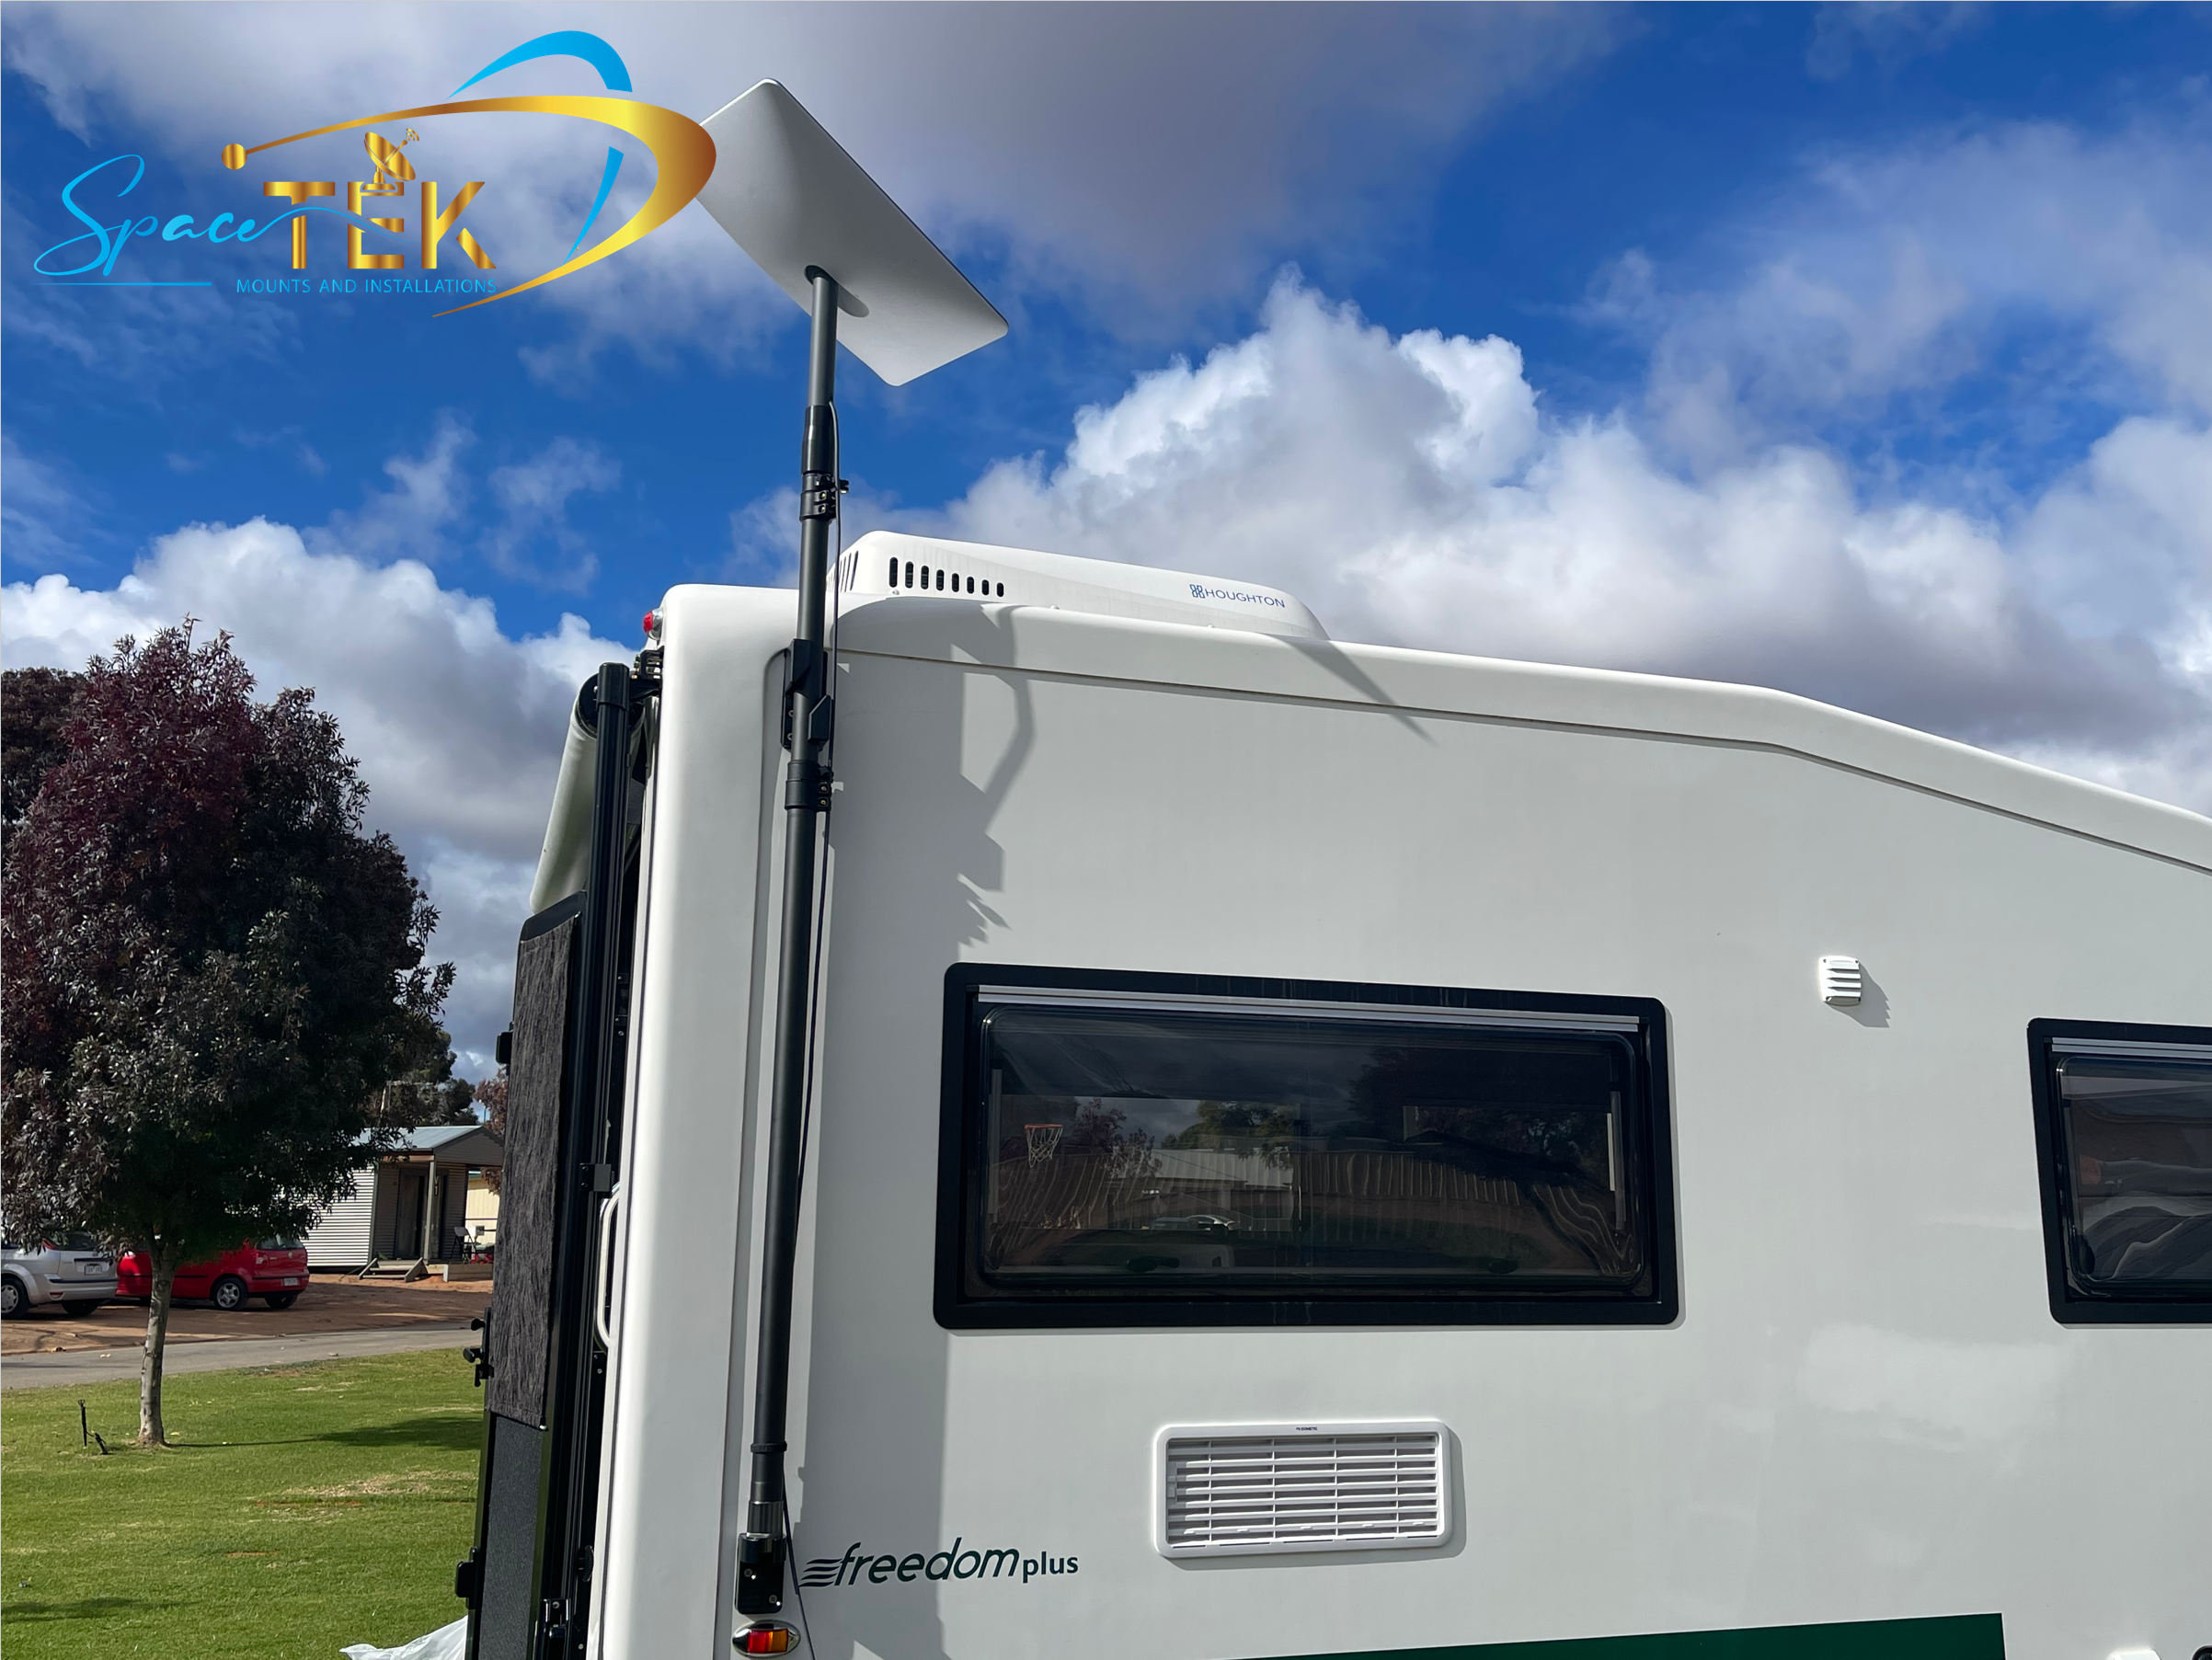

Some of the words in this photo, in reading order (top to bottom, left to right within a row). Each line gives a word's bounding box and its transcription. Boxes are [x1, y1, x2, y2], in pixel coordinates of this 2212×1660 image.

[1204, 588, 1286, 608] HOUGHTON
[833, 1537, 1021, 1586] freedom
[1022, 1551, 1079, 1584] plus
